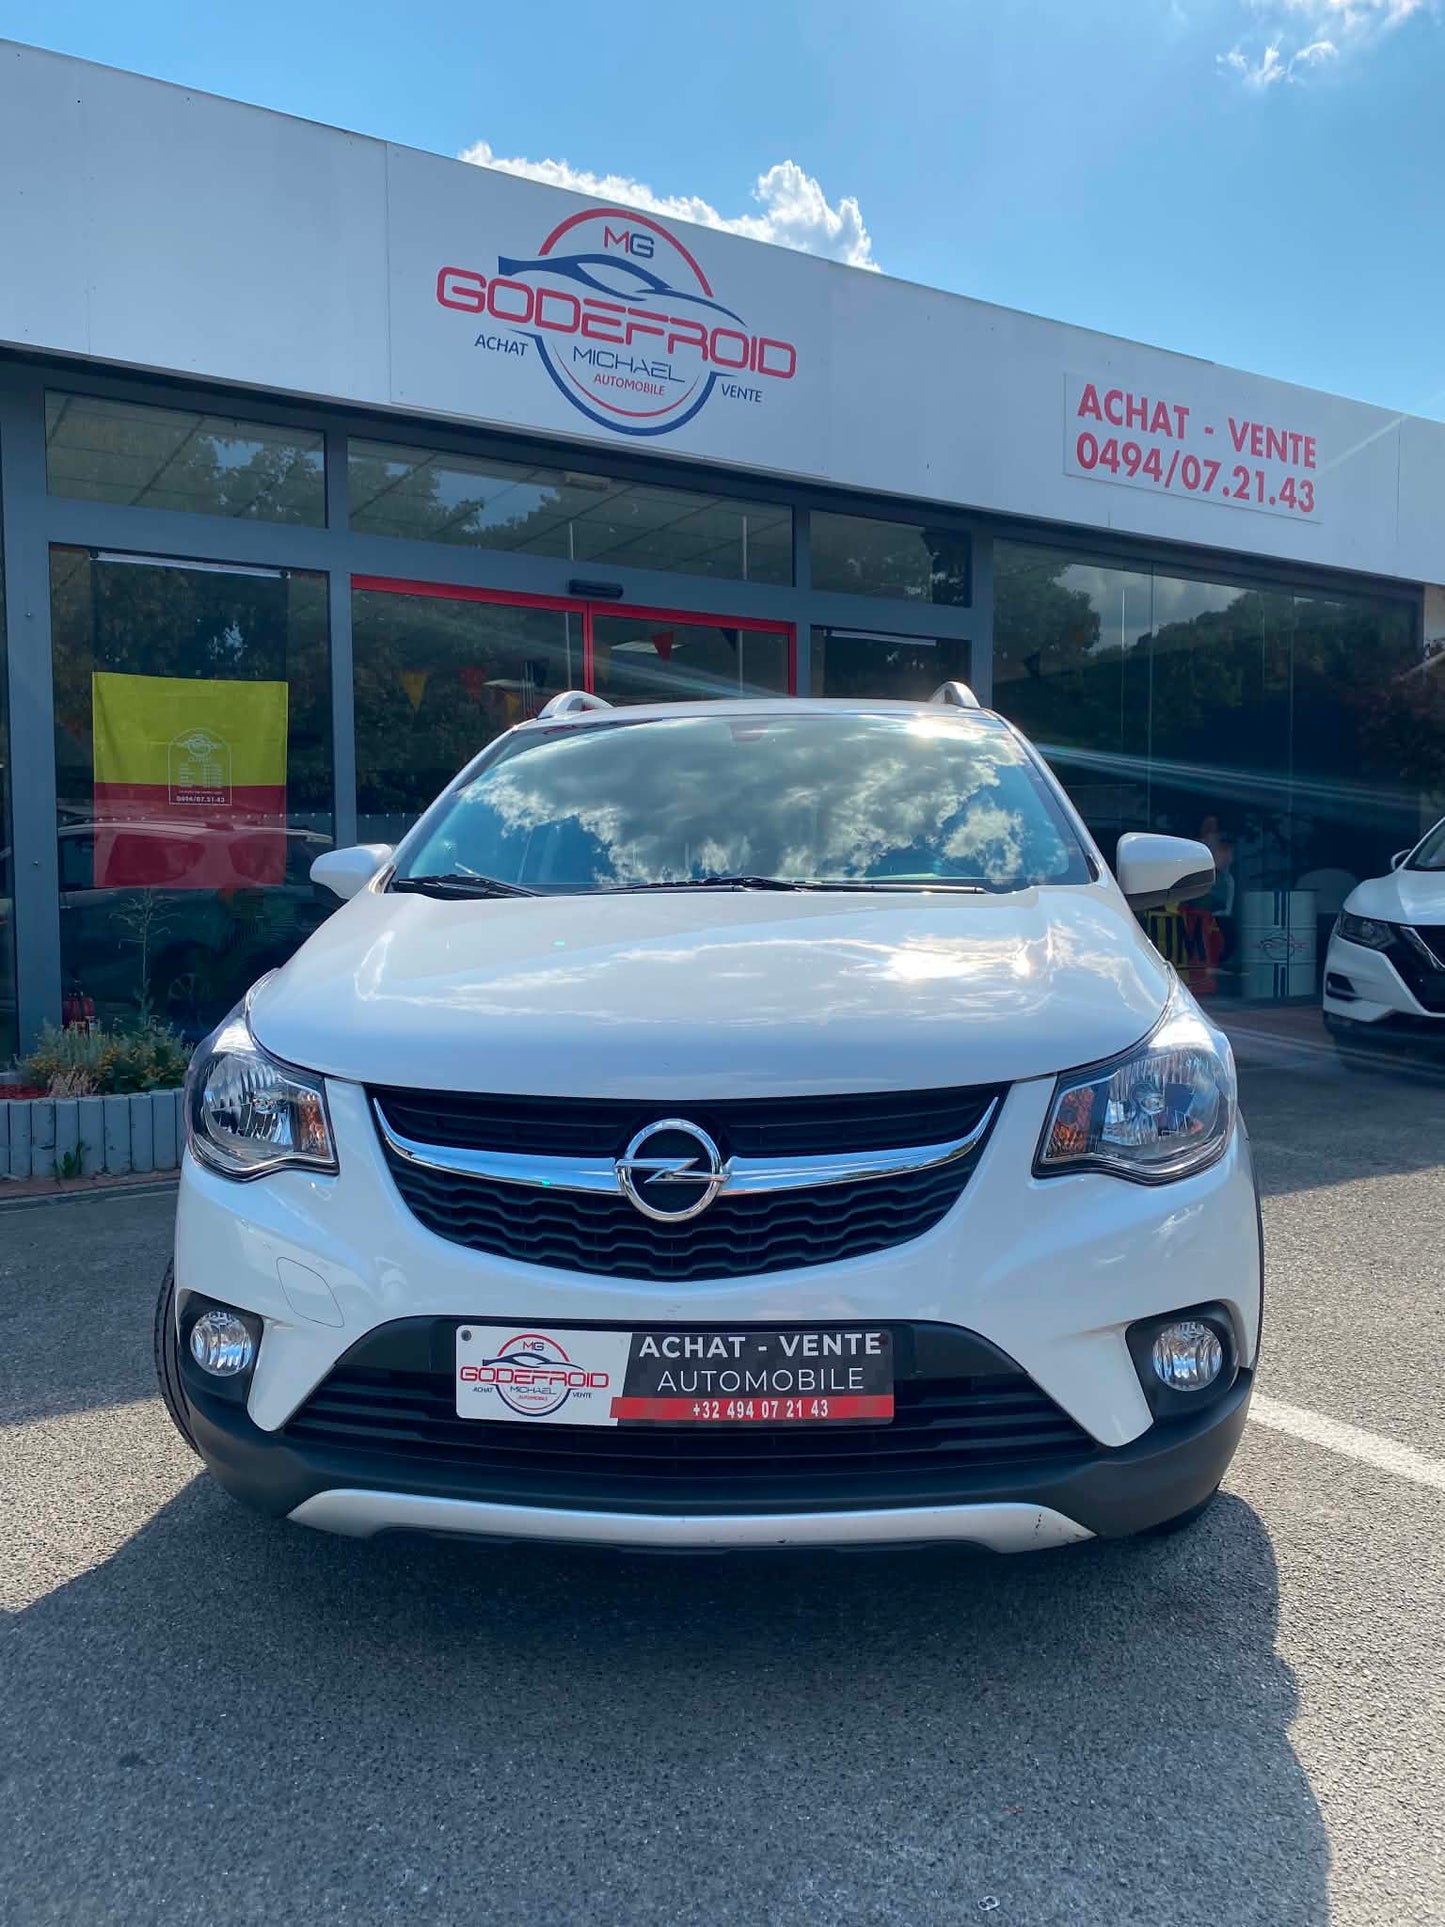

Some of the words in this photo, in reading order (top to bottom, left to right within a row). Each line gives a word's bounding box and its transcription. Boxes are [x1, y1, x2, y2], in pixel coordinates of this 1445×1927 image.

[604, 225, 654, 258] MG
[436, 266, 797, 379] GODEFROID
[474, 333, 529, 357] ACHAT
[573, 345, 685, 383] MICHAEL
[594, 373, 666, 396] AUTOMOBILE
[721, 383, 763, 404] VENTE
[1077, 383, 1190, 440] ACHAT
[1228, 417, 1317, 469] VENTE
[1076, 431, 1315, 513] 0494/07.21.43
[523, 1341, 544, 1351] MG
[639, 1336, 746, 1358] ACHAT
[779, 1333, 882, 1357] VENTE
[460, 1366, 609, 1389] GODEFROID
[657, 1367, 865, 1392] AUTOMOBILE
[510, 1386, 557, 1395] MICHAEL
[572, 1391, 592, 1399] VENTE
[693, 1400, 720, 1419] +32
[727, 1400, 754, 1418] 494
[761, 1400, 779, 1418] 07
[786, 1399, 802, 1418] 21
[811, 1399, 829, 1417] 43
